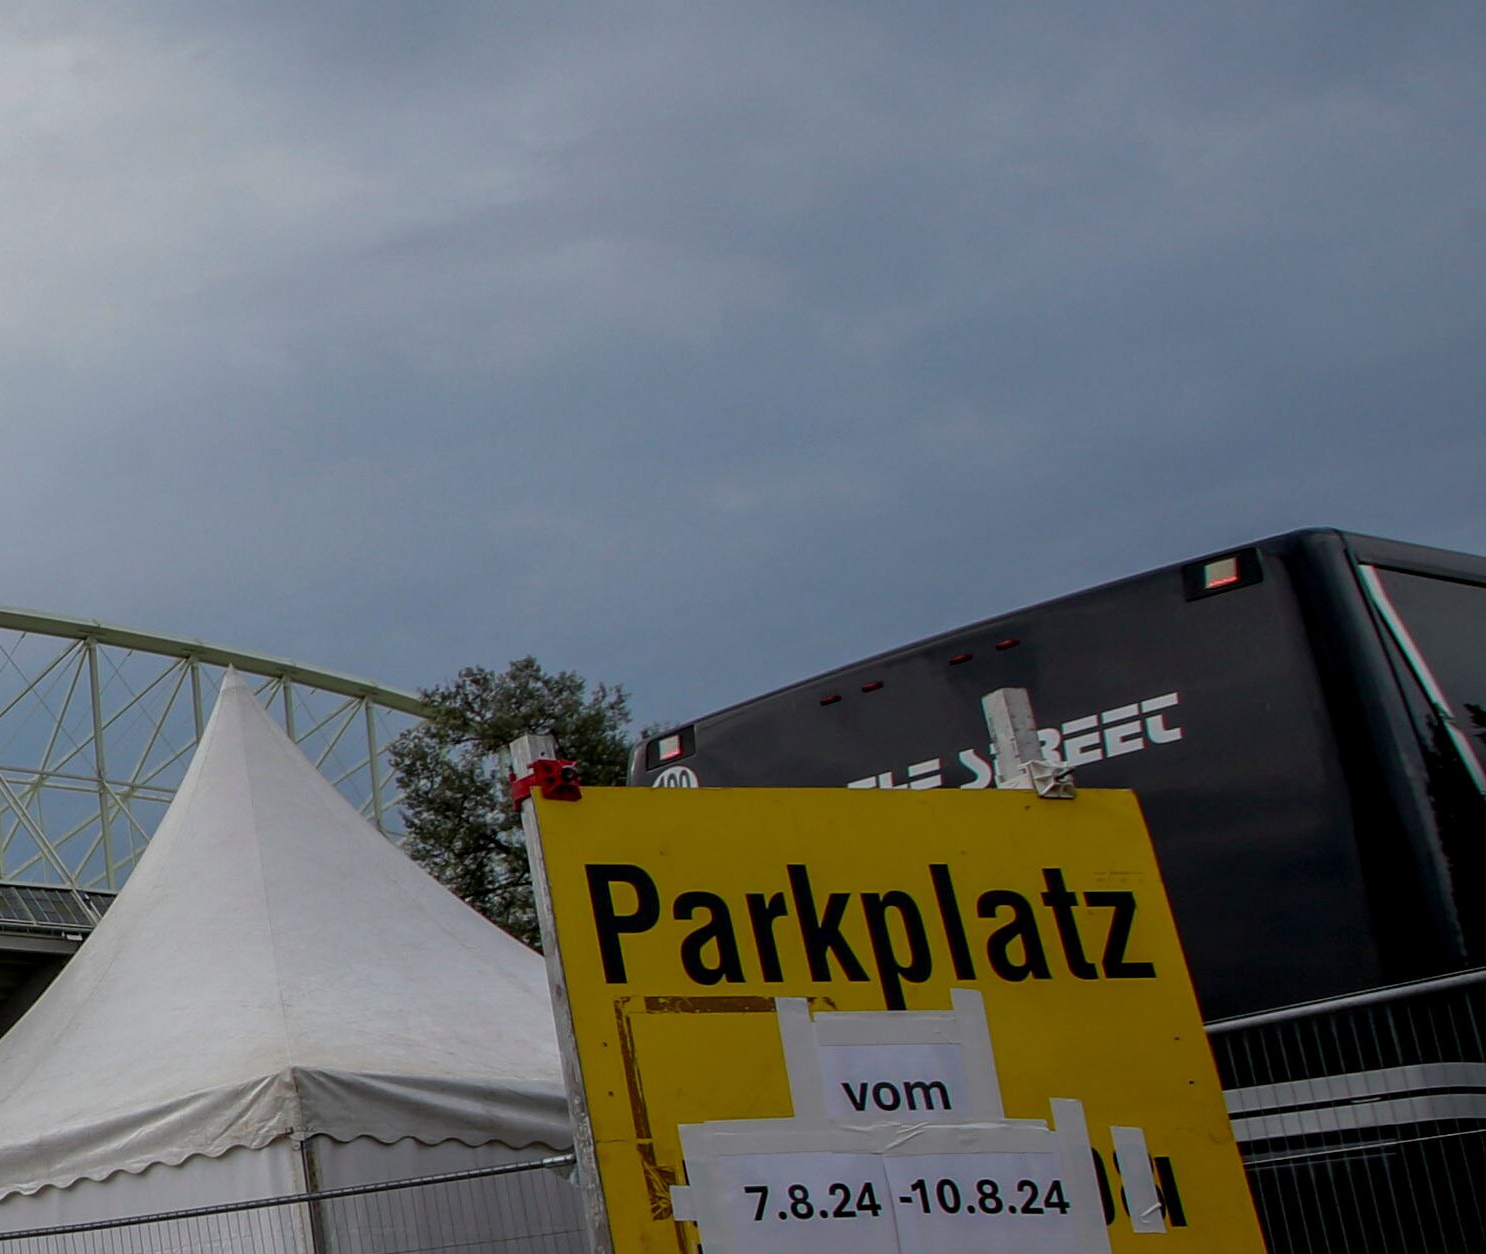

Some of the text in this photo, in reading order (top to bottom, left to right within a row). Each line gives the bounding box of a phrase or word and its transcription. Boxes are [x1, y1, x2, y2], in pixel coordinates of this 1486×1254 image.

[959, 692, 1182, 789] SREET
[584, 863, 1156, 1011] Parkplatz
[841, 1077, 951, 1112] vom
[743, 1182, 882, 1221] 7.8.24
